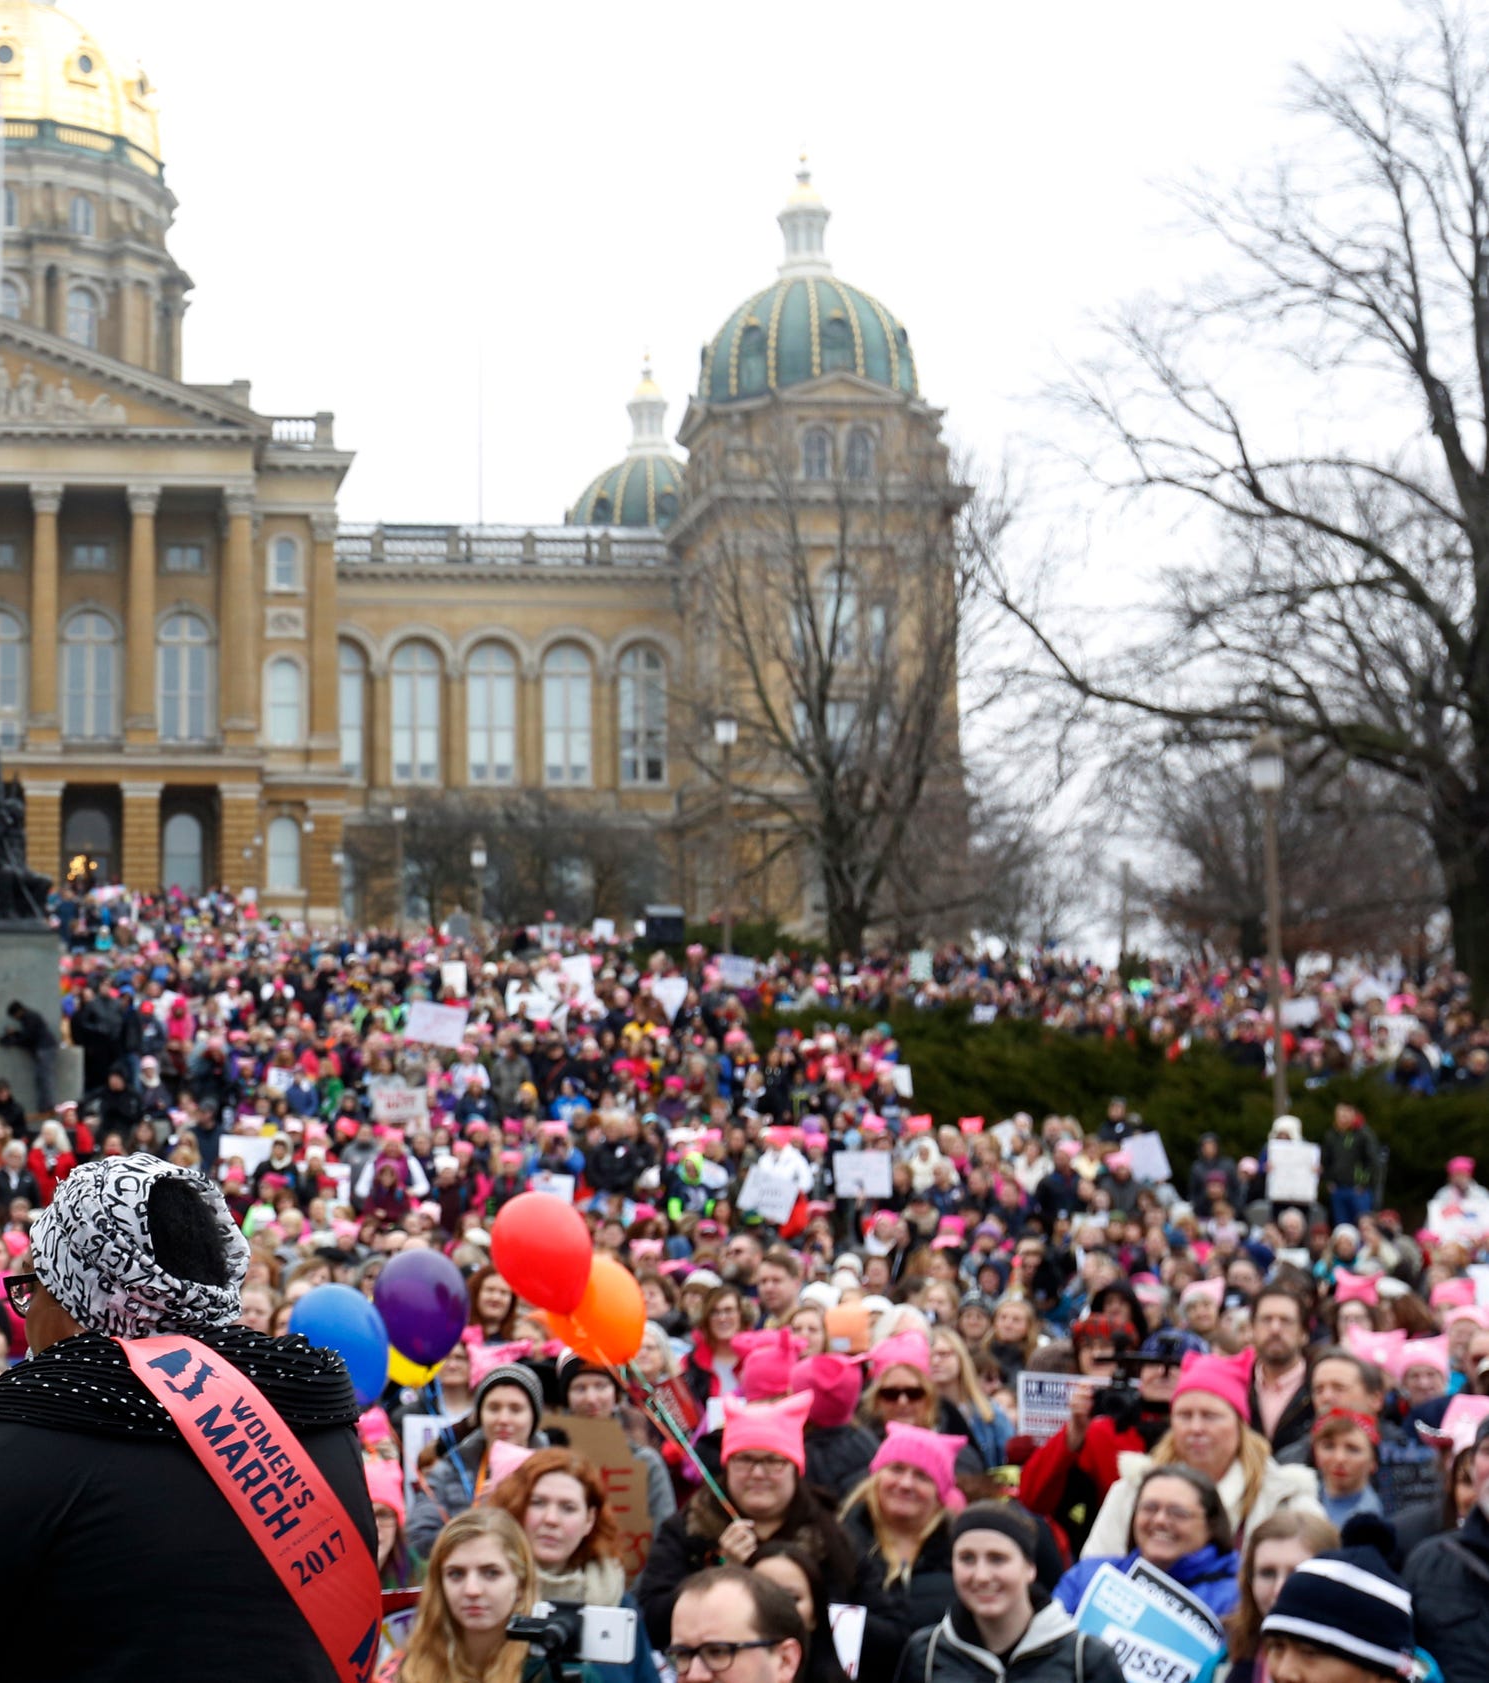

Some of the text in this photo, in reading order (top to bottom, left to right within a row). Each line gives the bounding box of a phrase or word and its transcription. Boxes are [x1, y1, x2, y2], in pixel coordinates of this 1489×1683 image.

[194, 1404, 300, 1540] MARCH
[230, 1396, 315, 1509] WOMEN'S
[291, 1529, 346, 1587] 2017
